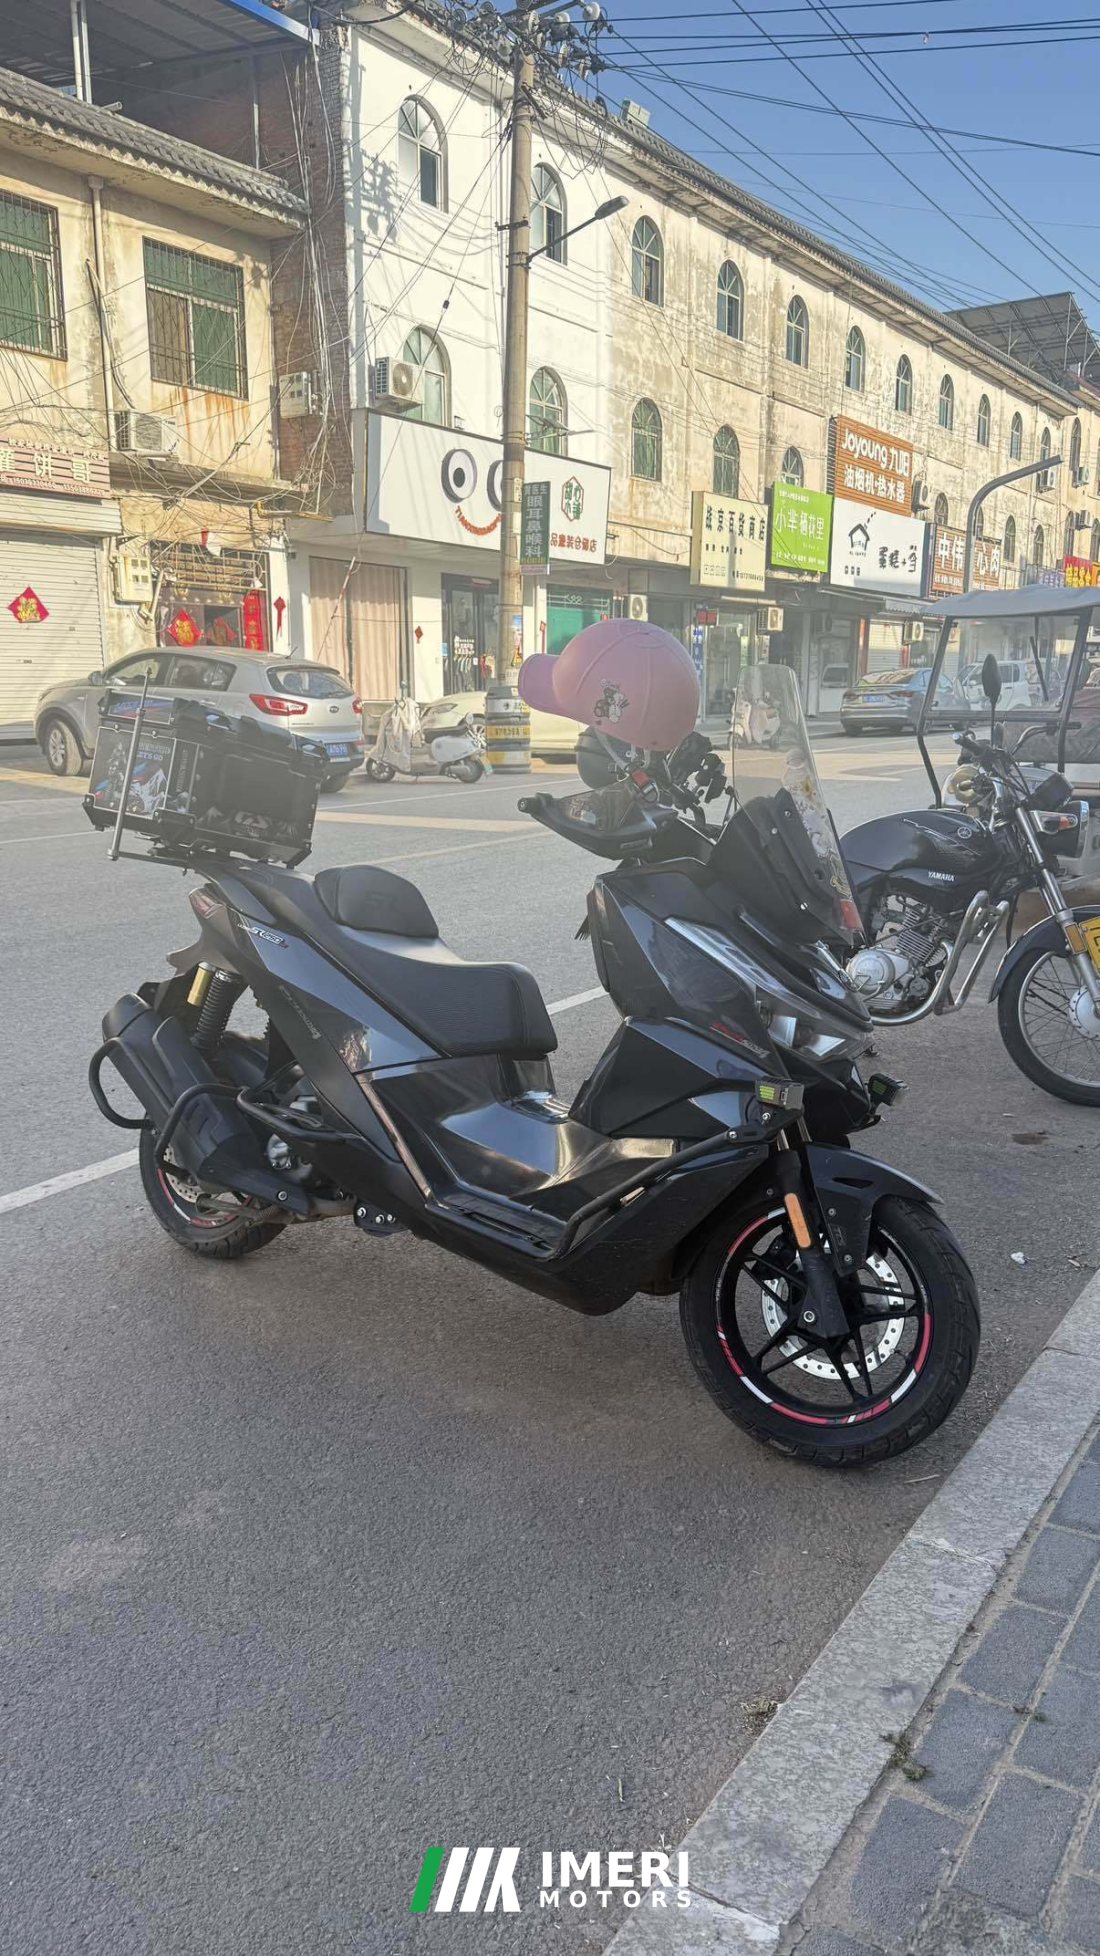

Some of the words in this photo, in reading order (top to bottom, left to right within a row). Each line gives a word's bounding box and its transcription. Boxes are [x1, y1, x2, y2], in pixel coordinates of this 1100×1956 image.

[841, 428, 887, 470] Joyoung
[525, 495, 544, 557] 眼耳鼻喉科
[928, 871, 955, 882] YAMAHA
